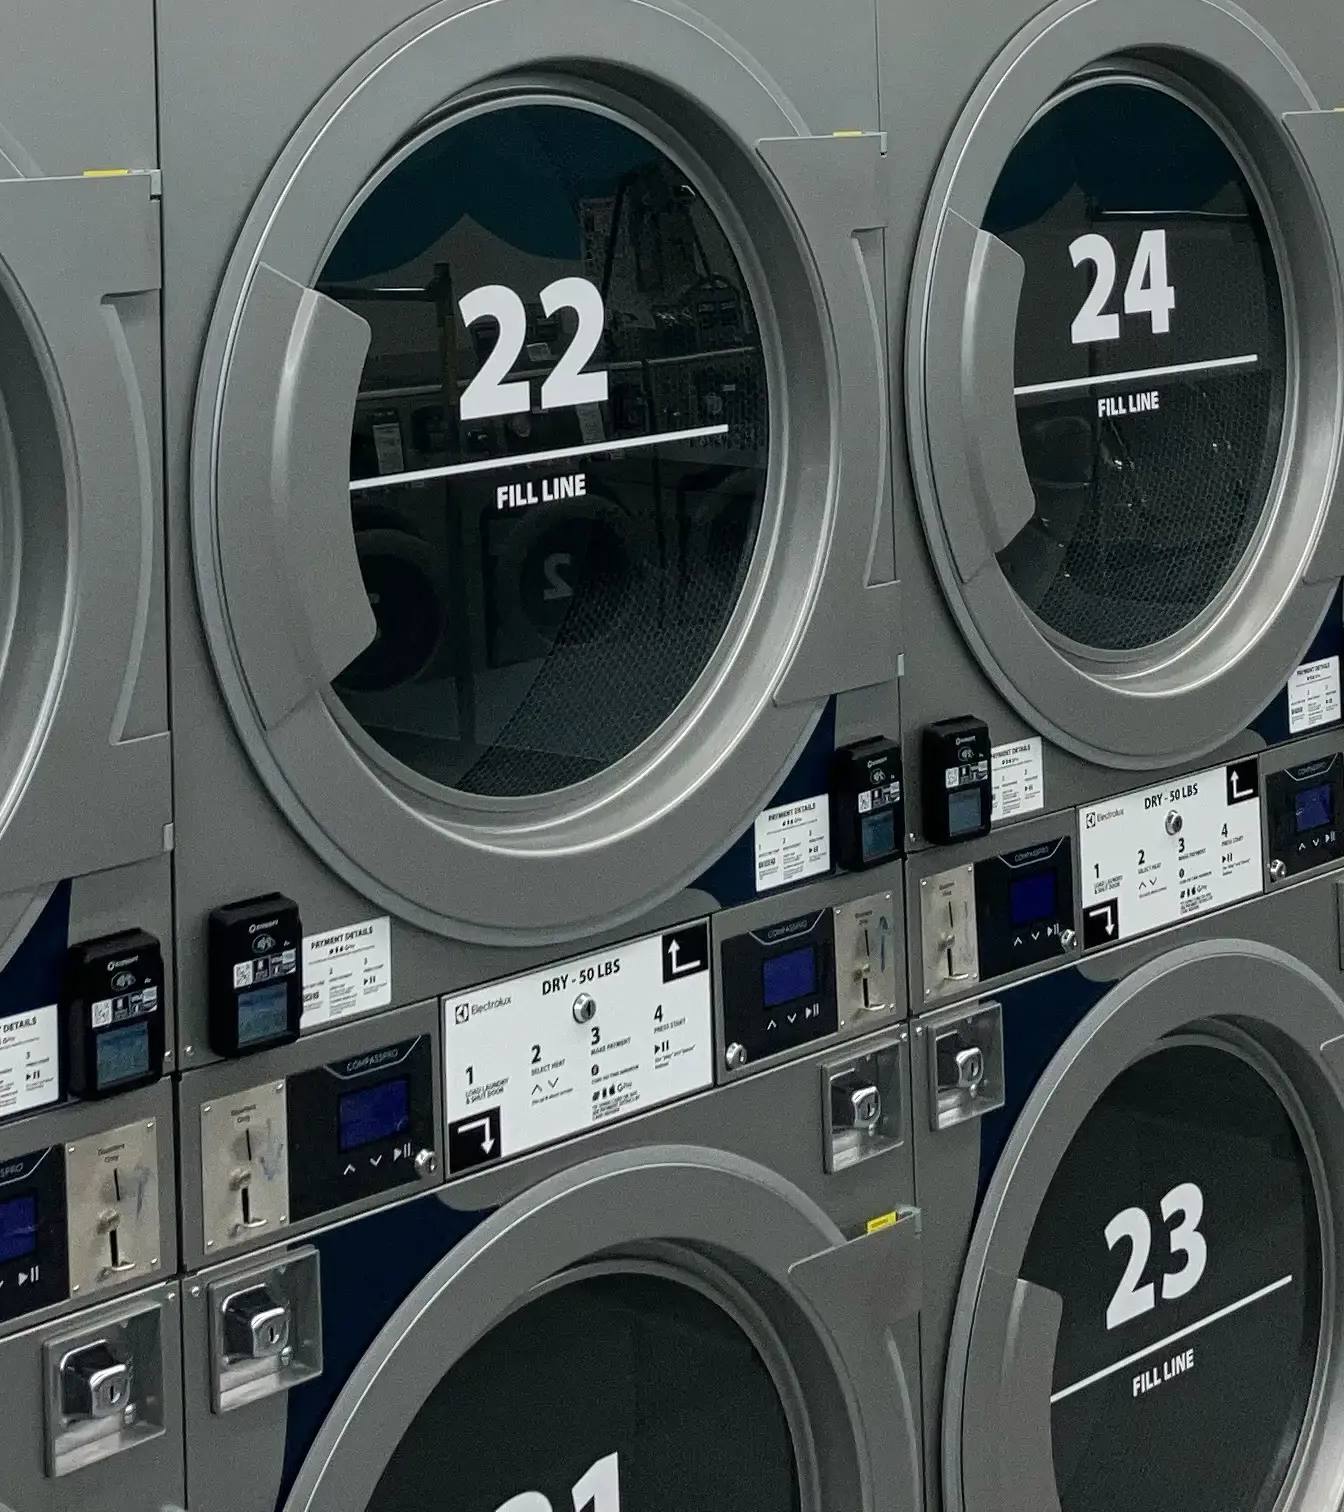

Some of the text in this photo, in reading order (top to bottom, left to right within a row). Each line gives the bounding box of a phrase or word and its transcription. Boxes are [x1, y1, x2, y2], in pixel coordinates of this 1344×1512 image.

[1068, 229, 1175, 344] 24
[458, 277, 608, 421] 22
[1098, 390, 1159, 417] FILL LINE
[496, 473, 586, 510] FILL LINE
[1144, 794, 1163, 810] DRY
[1169, 789, 1180, 803] 50
[1182, 783, 1198, 798] LBS
[1221, 823, 1228, 837] 4
[1178, 837, 1185, 853] 3
[1137, 849, 1145, 865] 2
[1094, 863, 1100, 879] 1
[311, 934, 343, 949] PAYMENT
[542, 974, 569, 996] DRY
[579, 968, 594, 984] 50
[597, 959, 621, 978] LBS
[471, 995, 512, 1016] Electrolux
[653, 1004, 663, 1023] 4
[3, 1017, 37, 1032] DETAILS
[590, 1026, 601, 1046] 3
[531, 1045, 541, 1064] 2
[466, 1065, 474, 1085] 1
[1104, 1182, 1207, 1330] 23
[1132, 1348, 1194, 1397] FILL LINE
